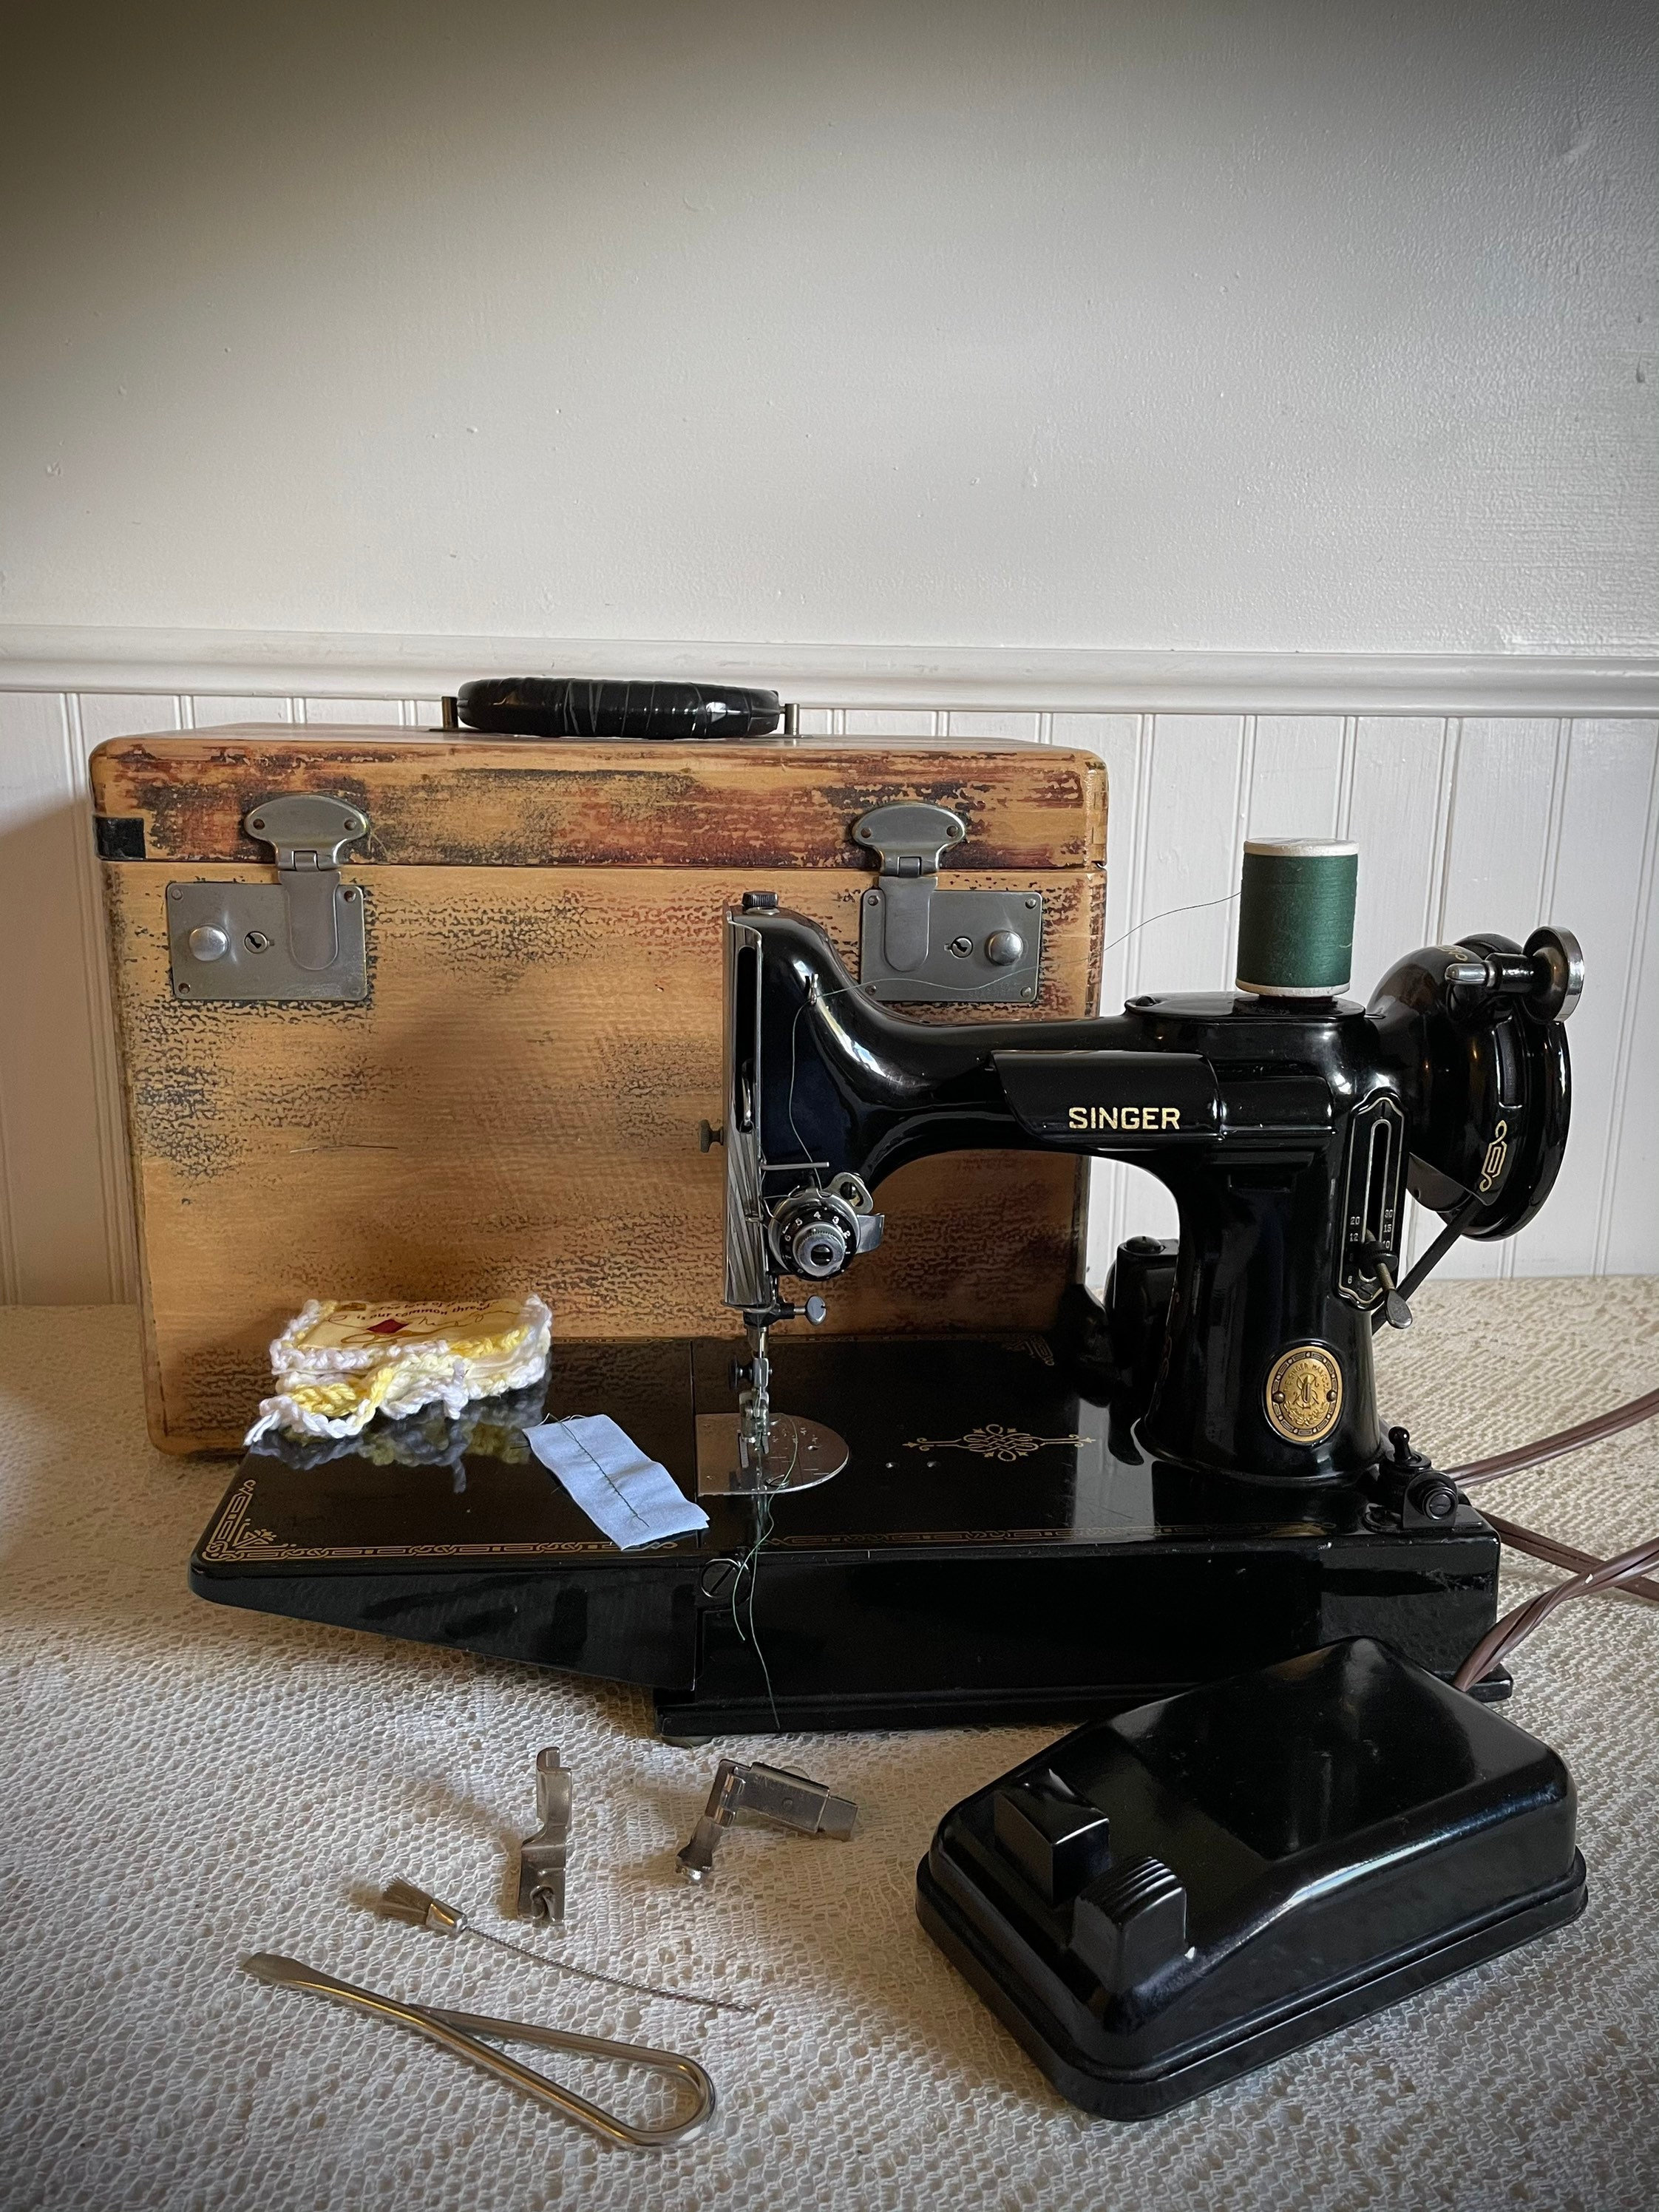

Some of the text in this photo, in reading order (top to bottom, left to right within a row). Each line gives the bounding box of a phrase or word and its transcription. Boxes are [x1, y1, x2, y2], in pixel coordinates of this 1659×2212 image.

[1068, 1107, 1181, 1130] SINGER
[813, 1211, 821, 1221] 4
[1384, 1209, 1394, 1218] 30
[795, 1218, 803, 1226] 5
[832, 1215, 840, 1224] 3
[1350, 1216, 1360, 1225] 20
[1383, 1224, 1392, 1232] 15
[844, 1230, 851, 1239] 2
[1349, 1232, 1359, 1242] 12
[1348, 1275, 1353, 1284] 6
[395, 1309, 448, 1317] common
[1289, 1363, 1309, 1380] SINGER
